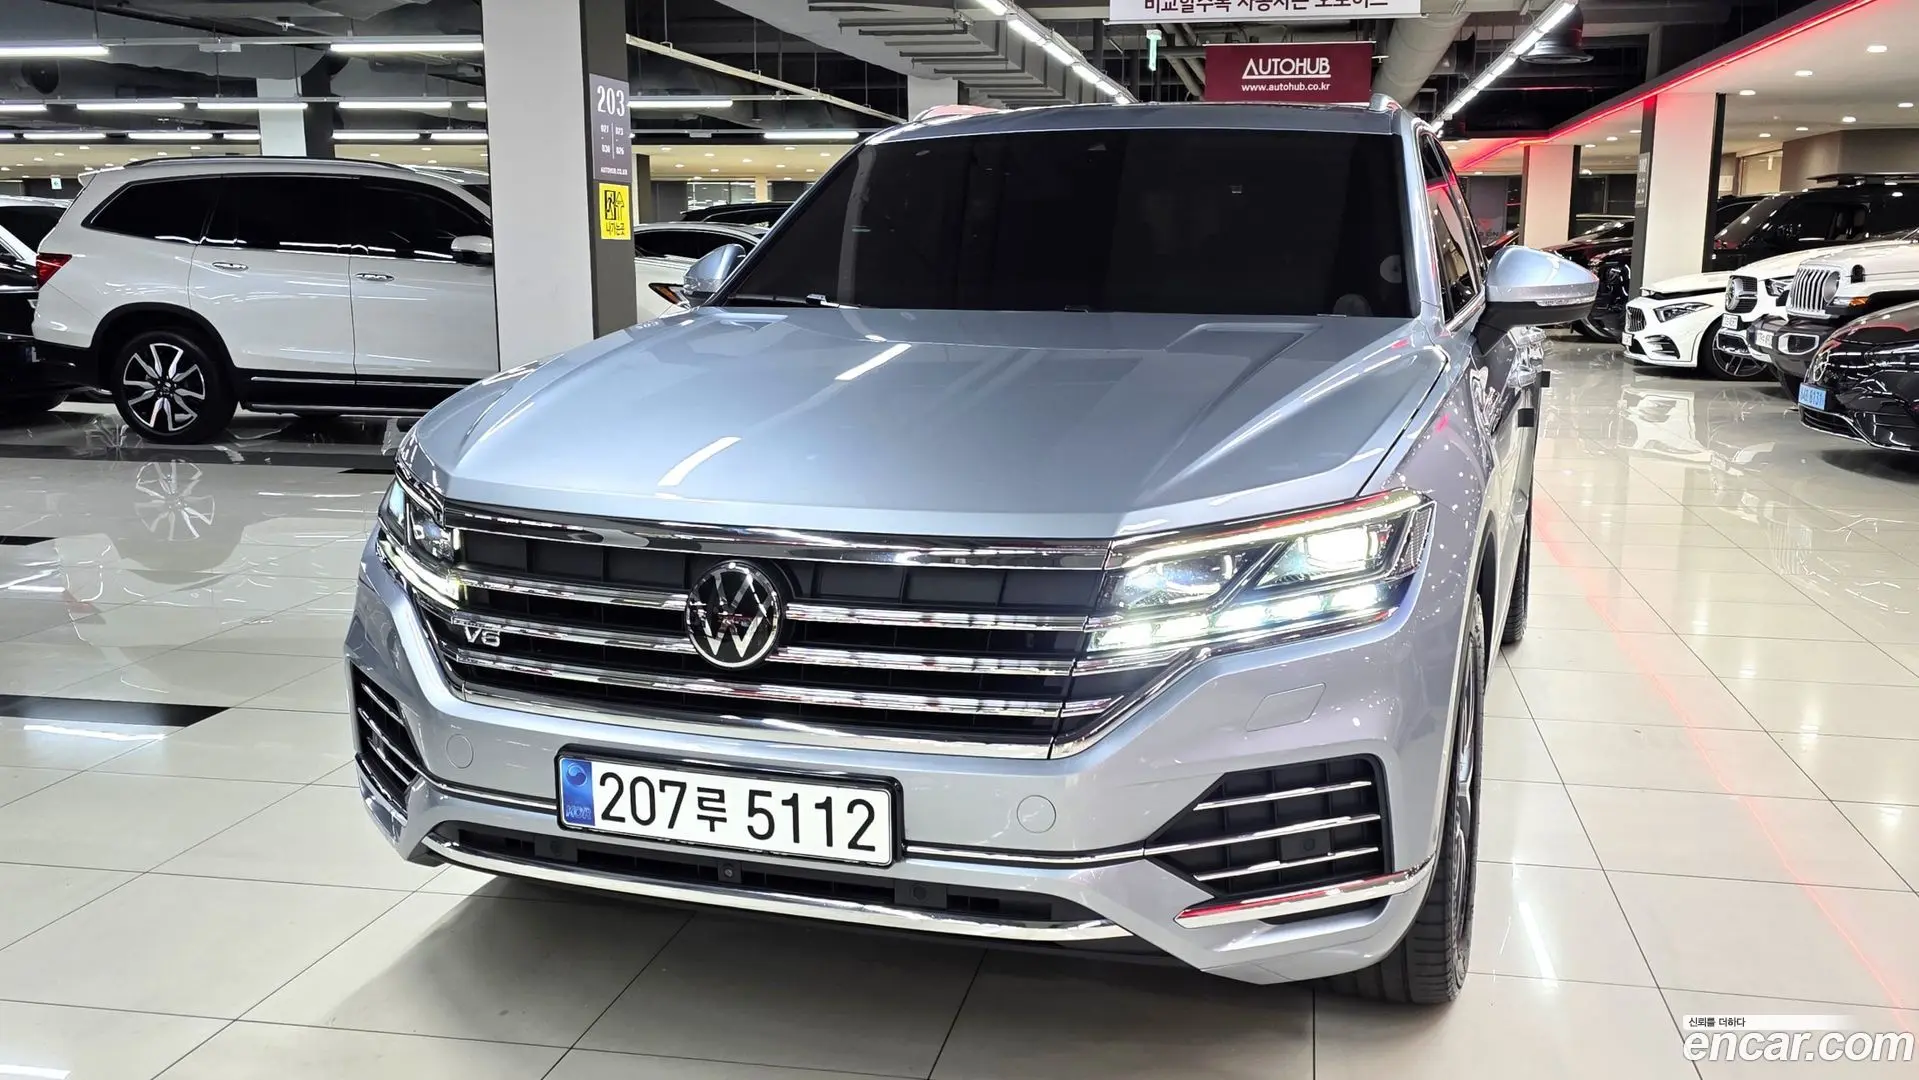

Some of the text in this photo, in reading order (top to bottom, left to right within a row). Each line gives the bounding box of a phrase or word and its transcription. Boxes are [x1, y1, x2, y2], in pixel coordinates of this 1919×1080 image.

[1242, 57, 1331, 79] AUTOHUB
[1241, 82, 1331, 92] www.autohub.co.kr
[597, 85, 625, 116] 203
[465, 626, 500, 647] V6
[565, 804, 592, 821] KOR
[599, 771, 876, 852] 207루 5112
